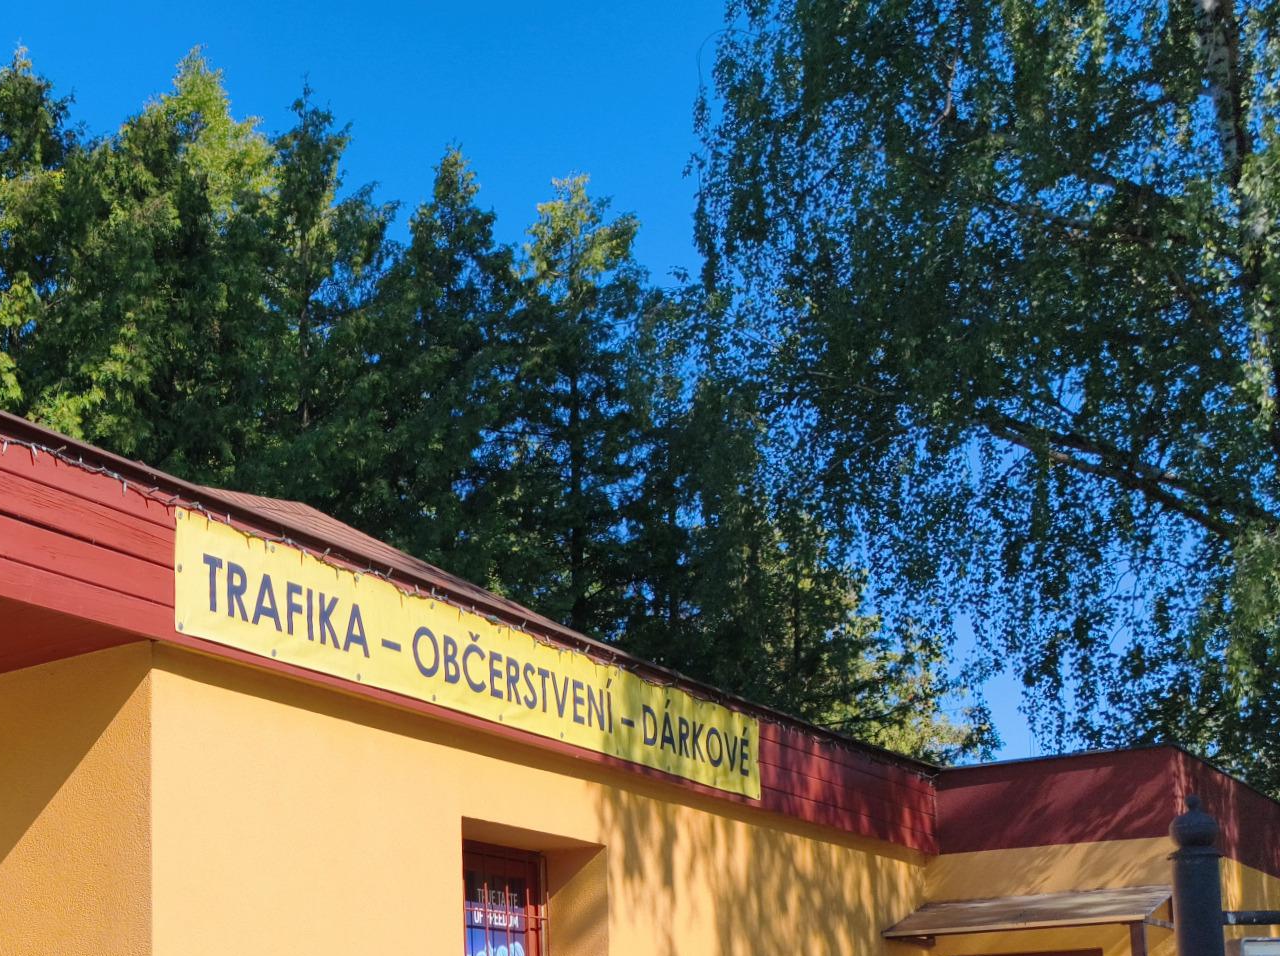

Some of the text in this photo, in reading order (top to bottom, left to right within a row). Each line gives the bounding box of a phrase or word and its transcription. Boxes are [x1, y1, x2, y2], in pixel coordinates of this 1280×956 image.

[202, 552, 370, 659] TRAFIKA
[412, 625, 614, 734] OBČERSTVENÍ
[642, 701, 751, 777] DÁRKOVÉ
[497, 890, 518, 909] TATE
